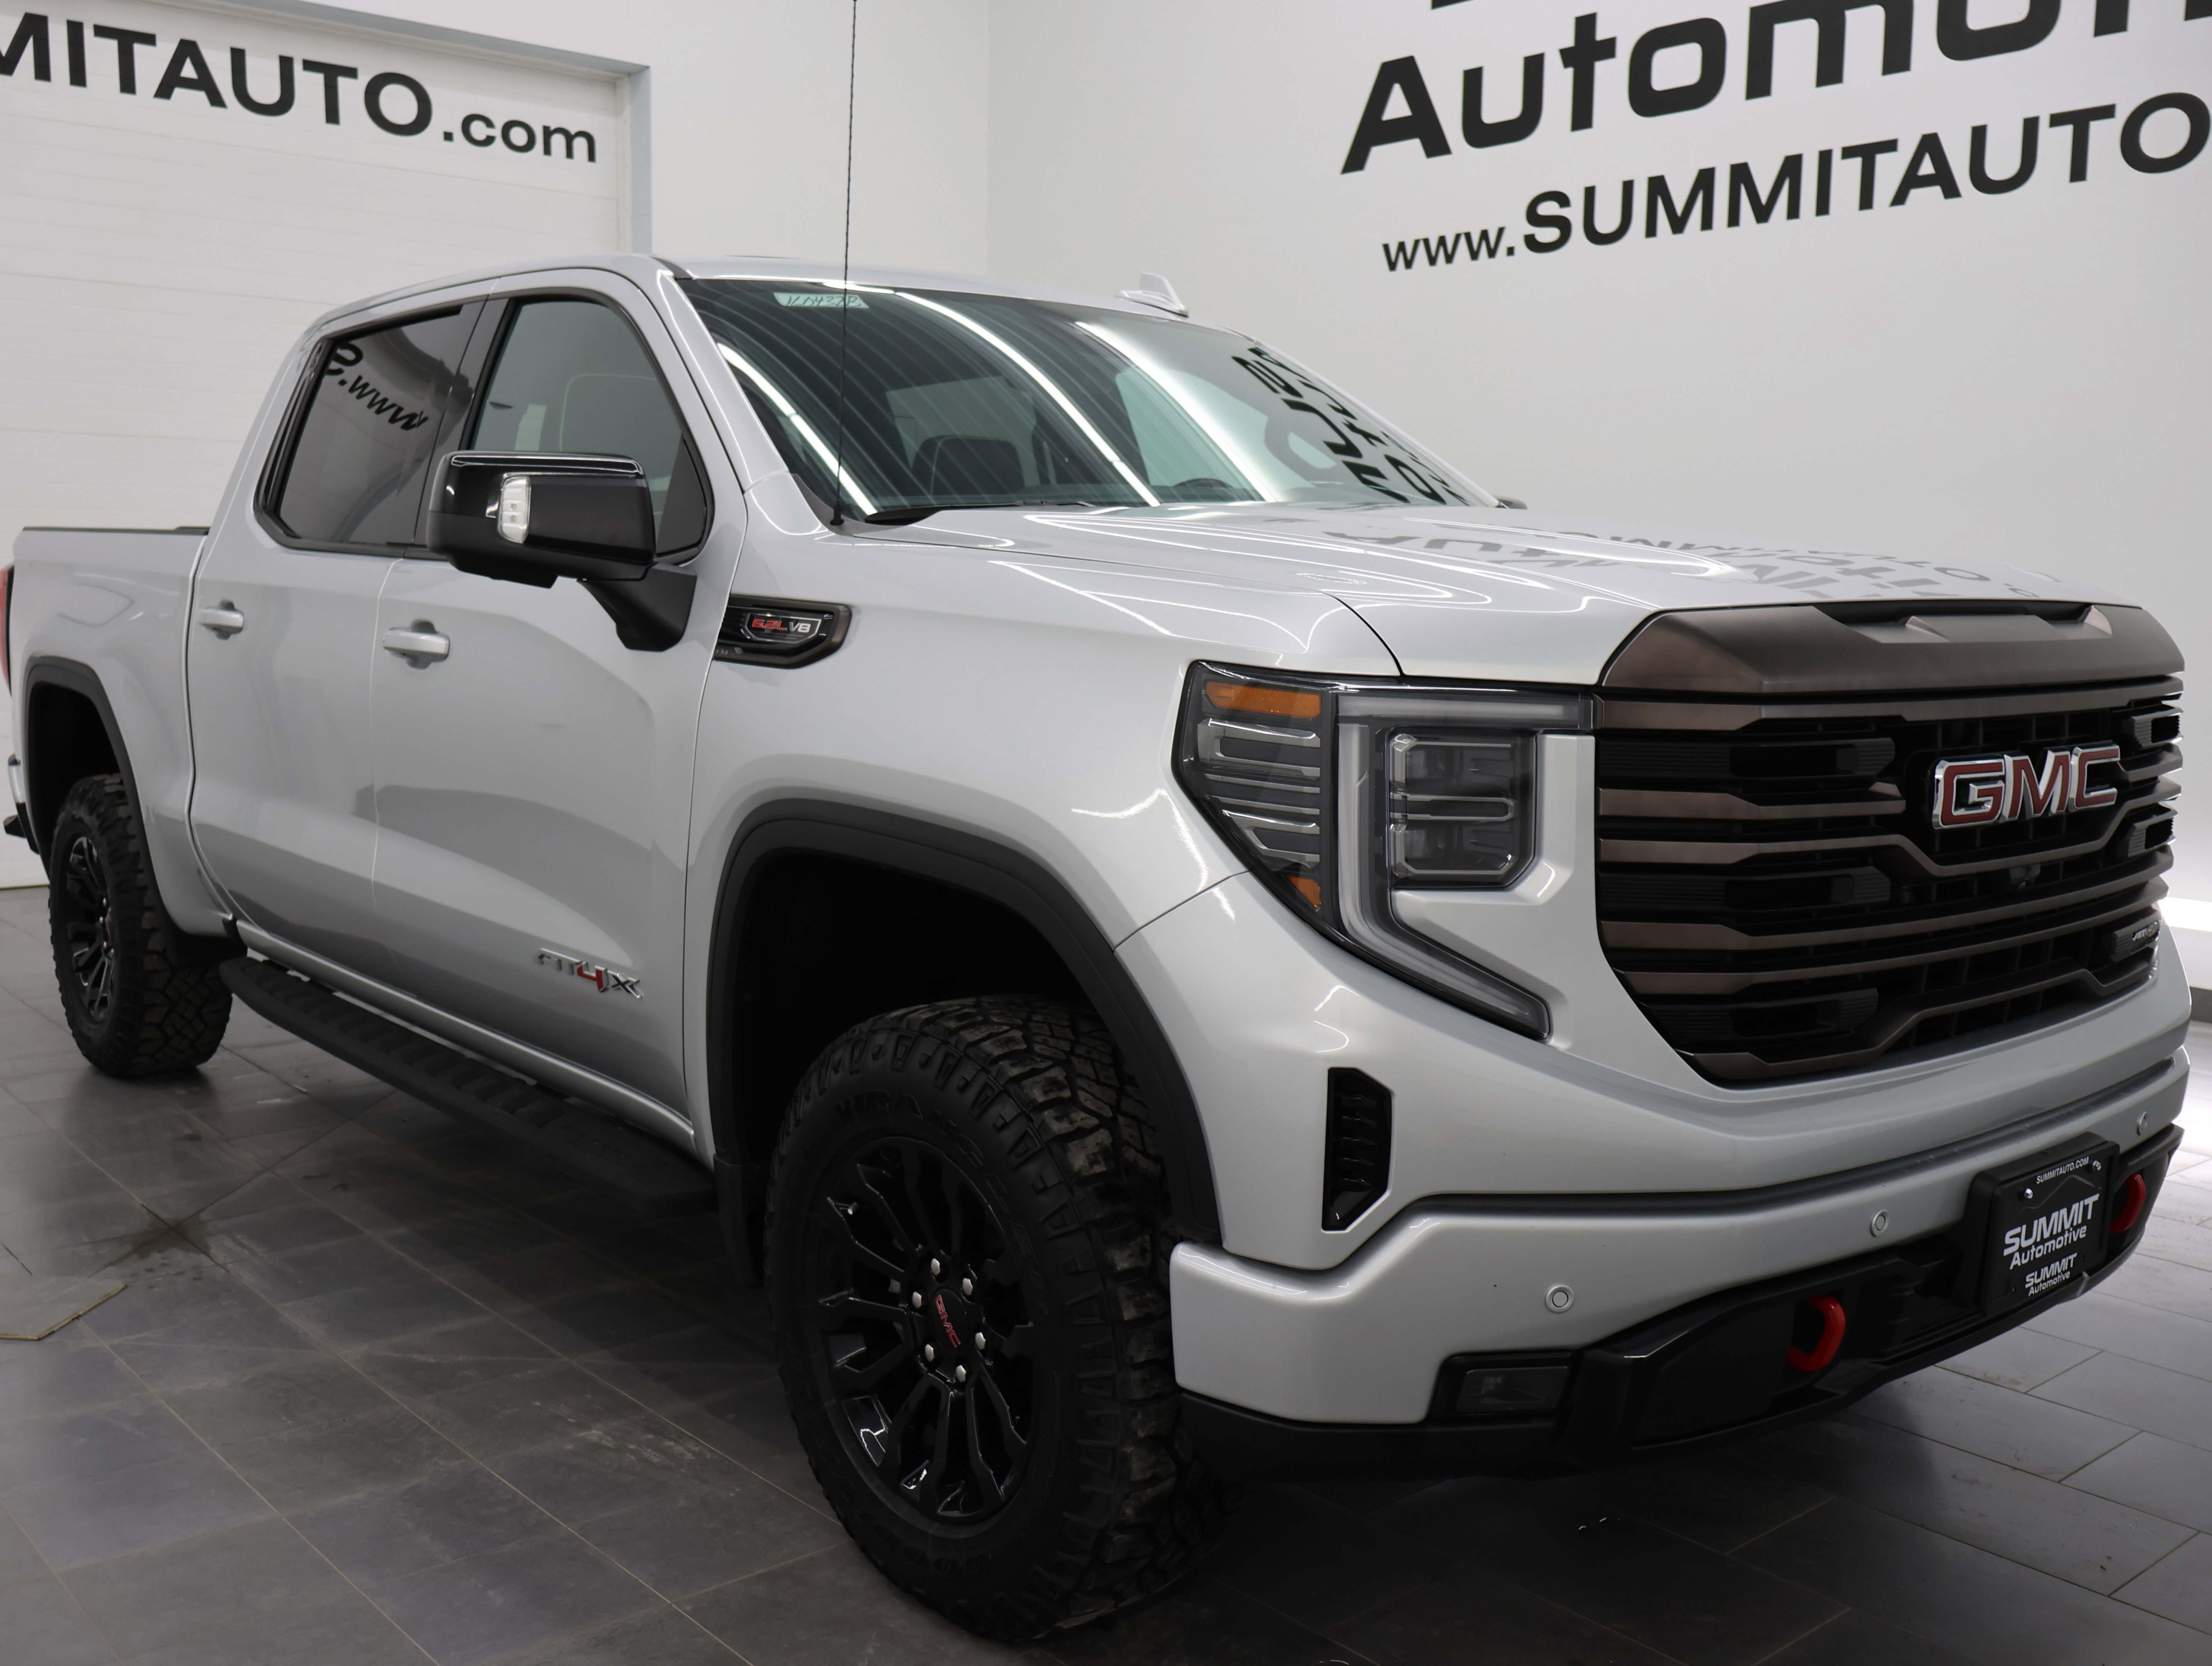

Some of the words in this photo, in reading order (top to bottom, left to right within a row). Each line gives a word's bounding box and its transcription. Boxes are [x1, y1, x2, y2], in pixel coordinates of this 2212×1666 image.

[1383, 93, 2211, 271] www.SUMMITAUTO
[752, 618, 788, 631] 6.2L
[789, 621, 812, 633] V8
[1932, 744, 2120, 830] GMC
[2036, 1157, 2089, 1184] SUMMITAUTO.COM
[2003, 1193, 2100, 1256] SUMMIT
[2010, 1225, 2087, 1270] Automotive
[2025, 1253, 2078, 1289] SUMMIT
[2028, 1270, 2071, 1297] Automotive
[935, 1294, 961, 1348] GMC
